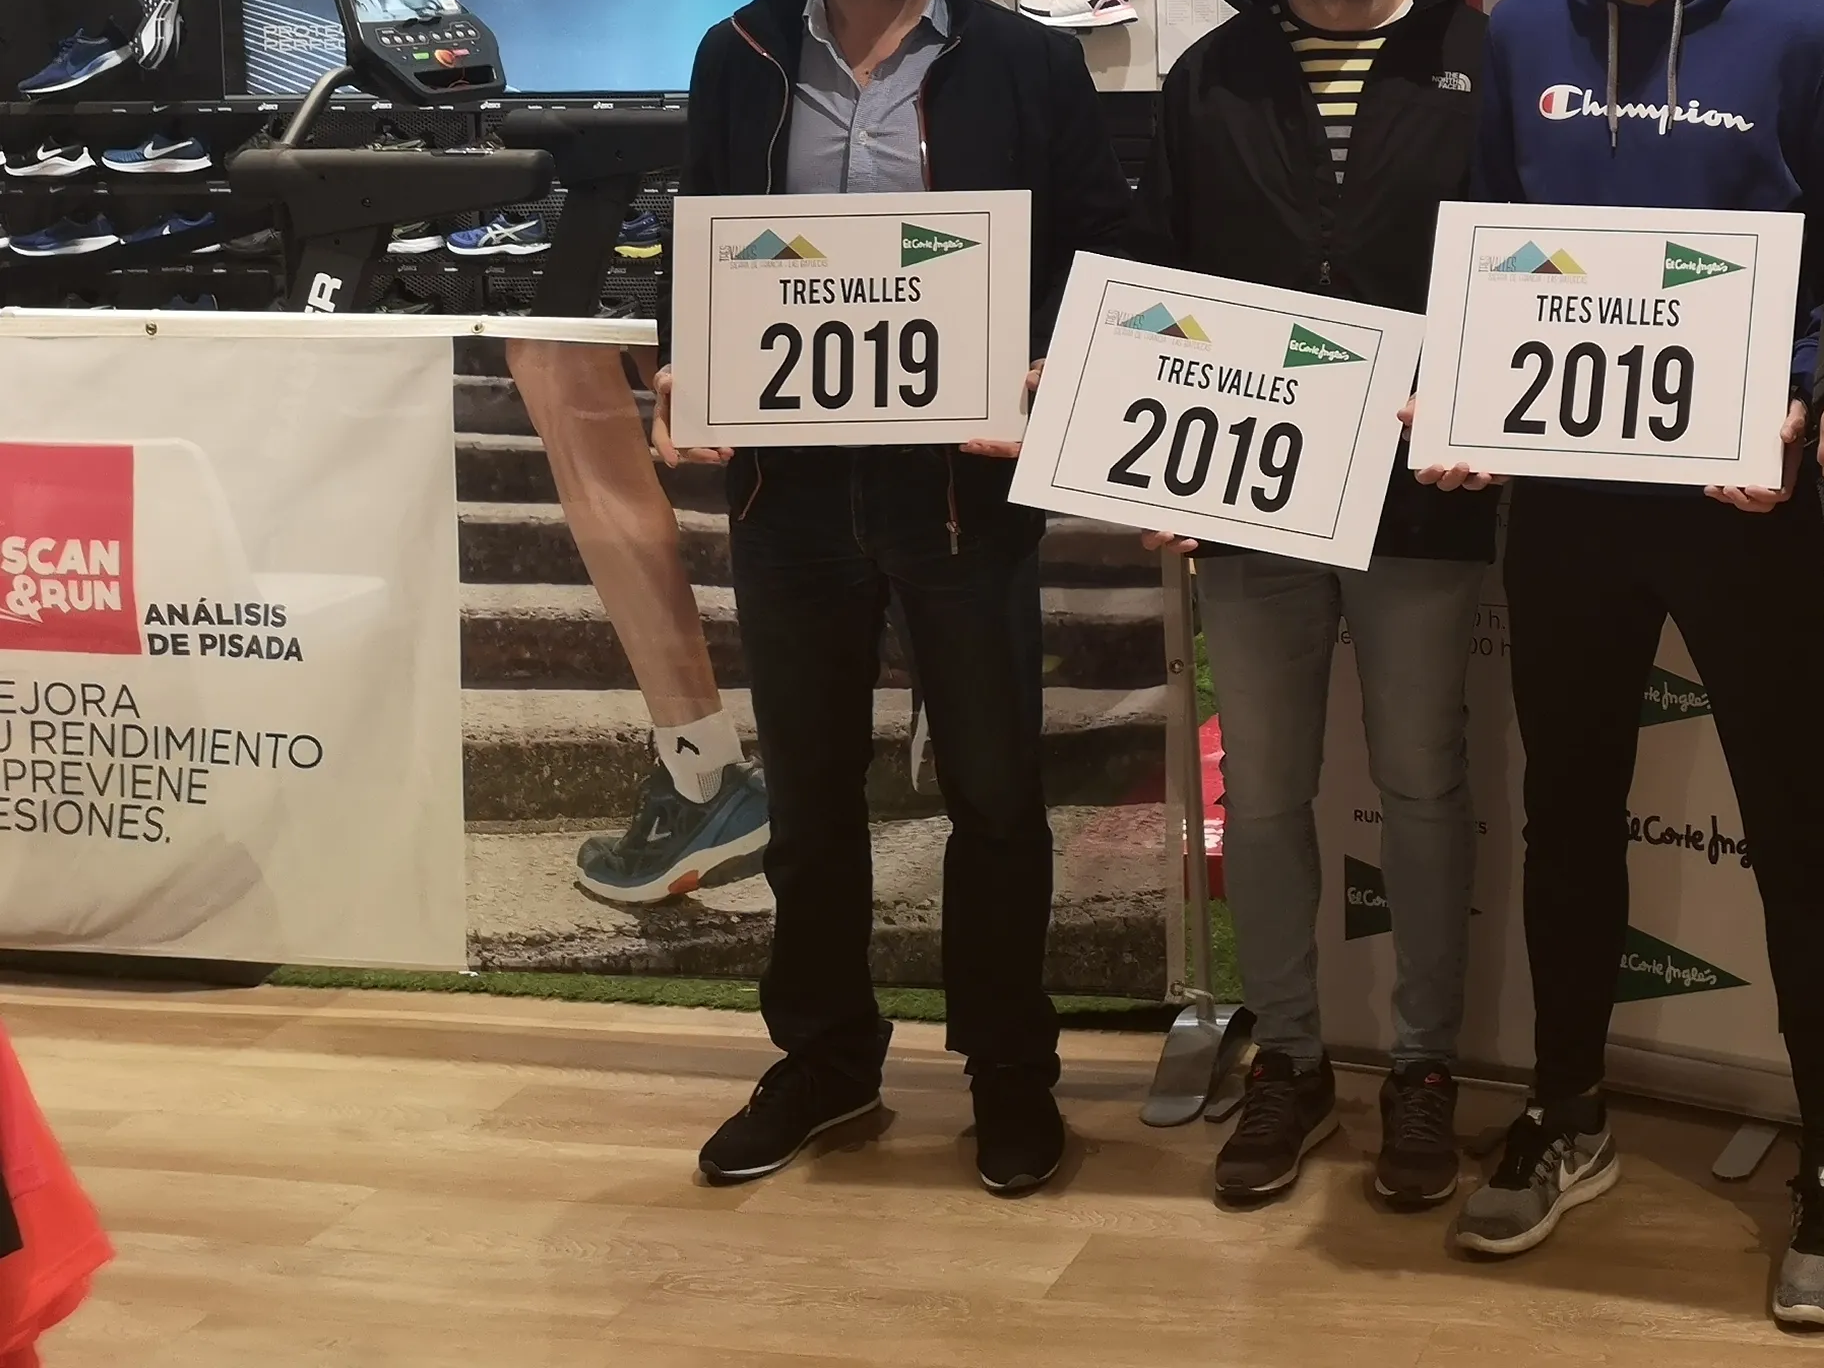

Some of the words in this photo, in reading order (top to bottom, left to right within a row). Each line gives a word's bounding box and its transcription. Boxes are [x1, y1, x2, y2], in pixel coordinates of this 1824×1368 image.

[1538, 83, 1755, 136] Champion
[779, 278, 835, 305] TRES
[840, 276, 921, 303] VALLES
[1536, 295, 1592, 323] TRES
[1599, 297, 1681, 327] VALLES
[759, 318, 939, 410] 2019
[1157, 354, 1214, 390] TRES
[1217, 366, 1299, 406] VALLES
[1503, 340, 1694, 443] 2019
[1107, 398, 1304, 513] 2019
[0, 535, 120, 575] SCAN
[5, 574, 122, 624] &RUN
[144, 597, 287, 628] ANÁLISIS
[147, 633, 191, 656] DE
[199, 633, 304, 662] PISADA
[0, 680, 140, 719] EJORA
[30, 720, 323, 769] RENDIMIENTO
[3, 758, 210, 805] PREVIENE
[1644, 816, 1704, 851] Corte
[1628, 953, 1664, 976] Corte
[1665, 955, 1718, 987] Inglés
